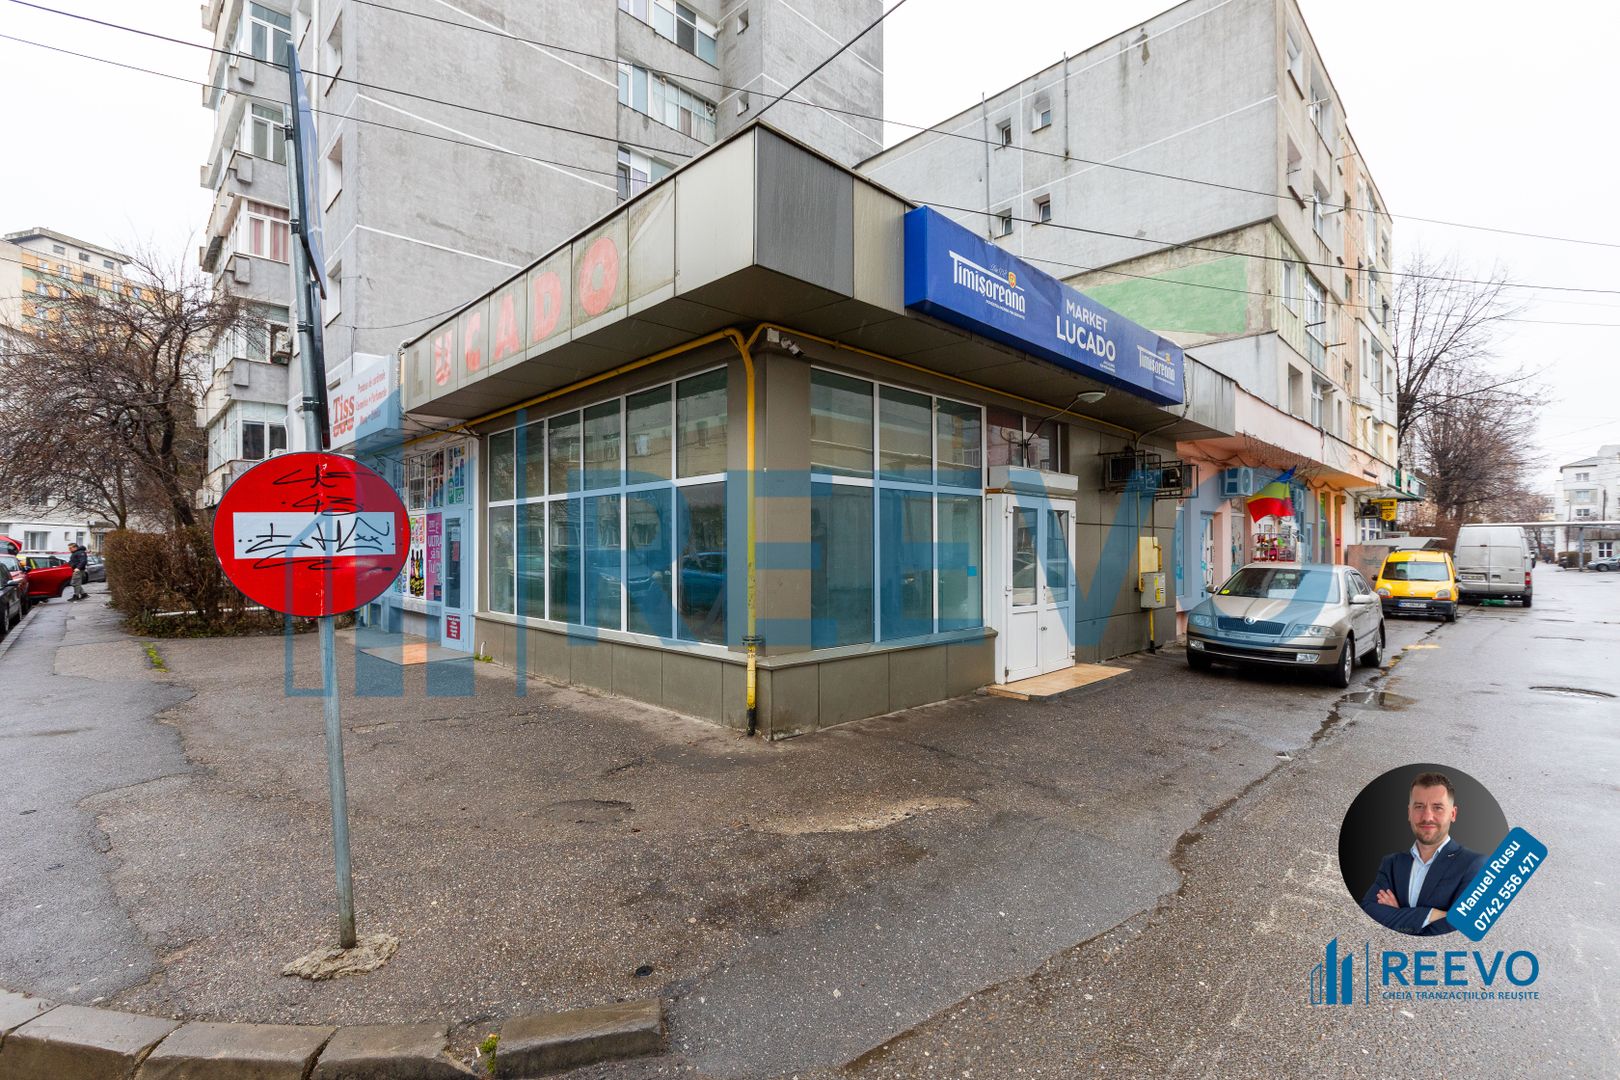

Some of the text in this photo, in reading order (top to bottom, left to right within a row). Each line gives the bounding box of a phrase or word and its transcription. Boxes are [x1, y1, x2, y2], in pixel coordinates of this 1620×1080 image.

[1066, 299, 1108, 333] MARKET
[1056, 315, 1116, 362] LUCADO
[333, 394, 355, 424] Tiss
